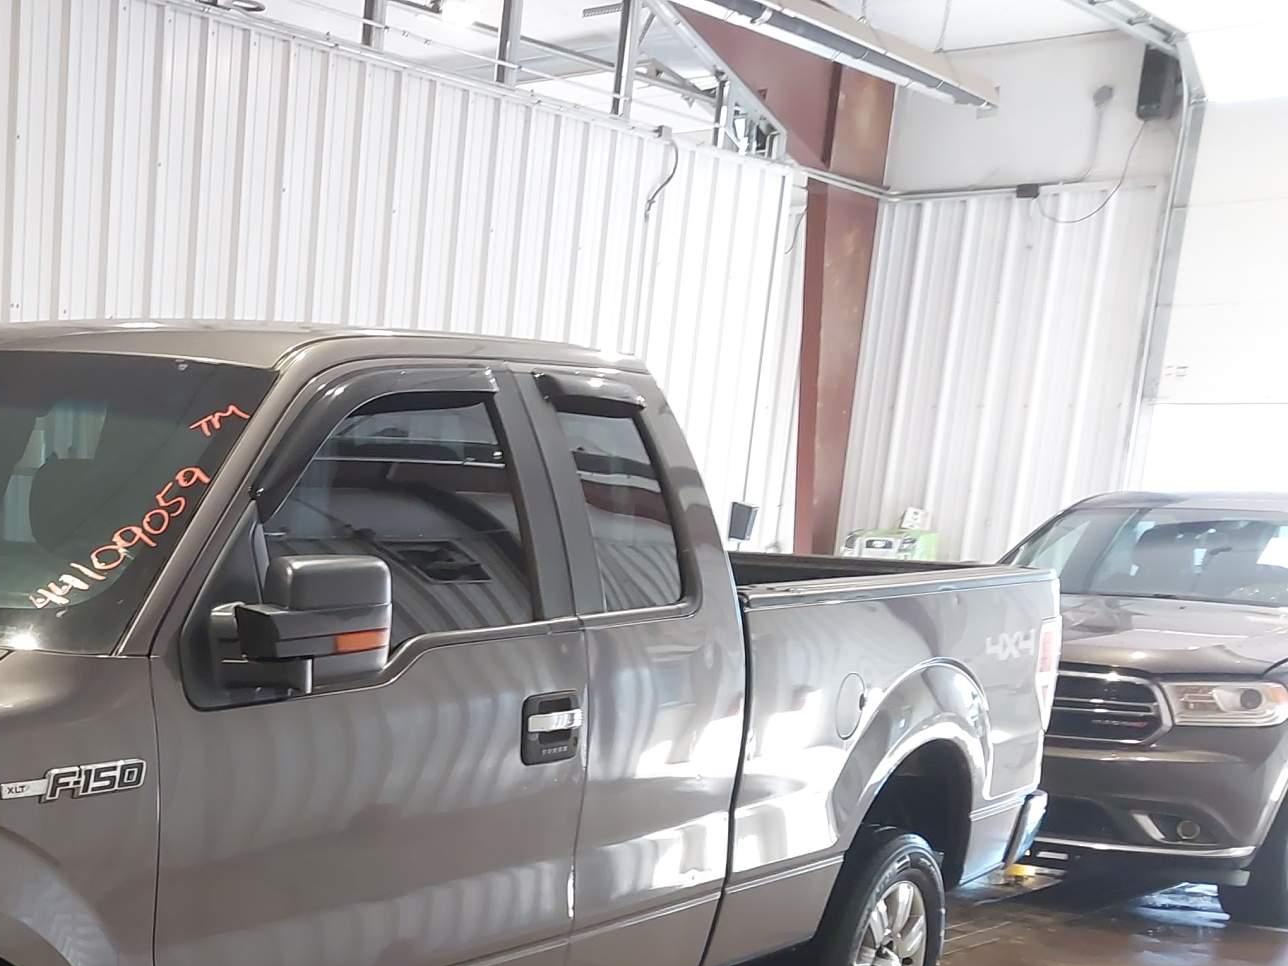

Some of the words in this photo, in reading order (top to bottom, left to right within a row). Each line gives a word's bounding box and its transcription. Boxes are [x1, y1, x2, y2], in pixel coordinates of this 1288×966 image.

[28, 466, 211, 608] 44109059
[6, 784, 27, 795] XLT
[47, 760, 146, 800] F-150
